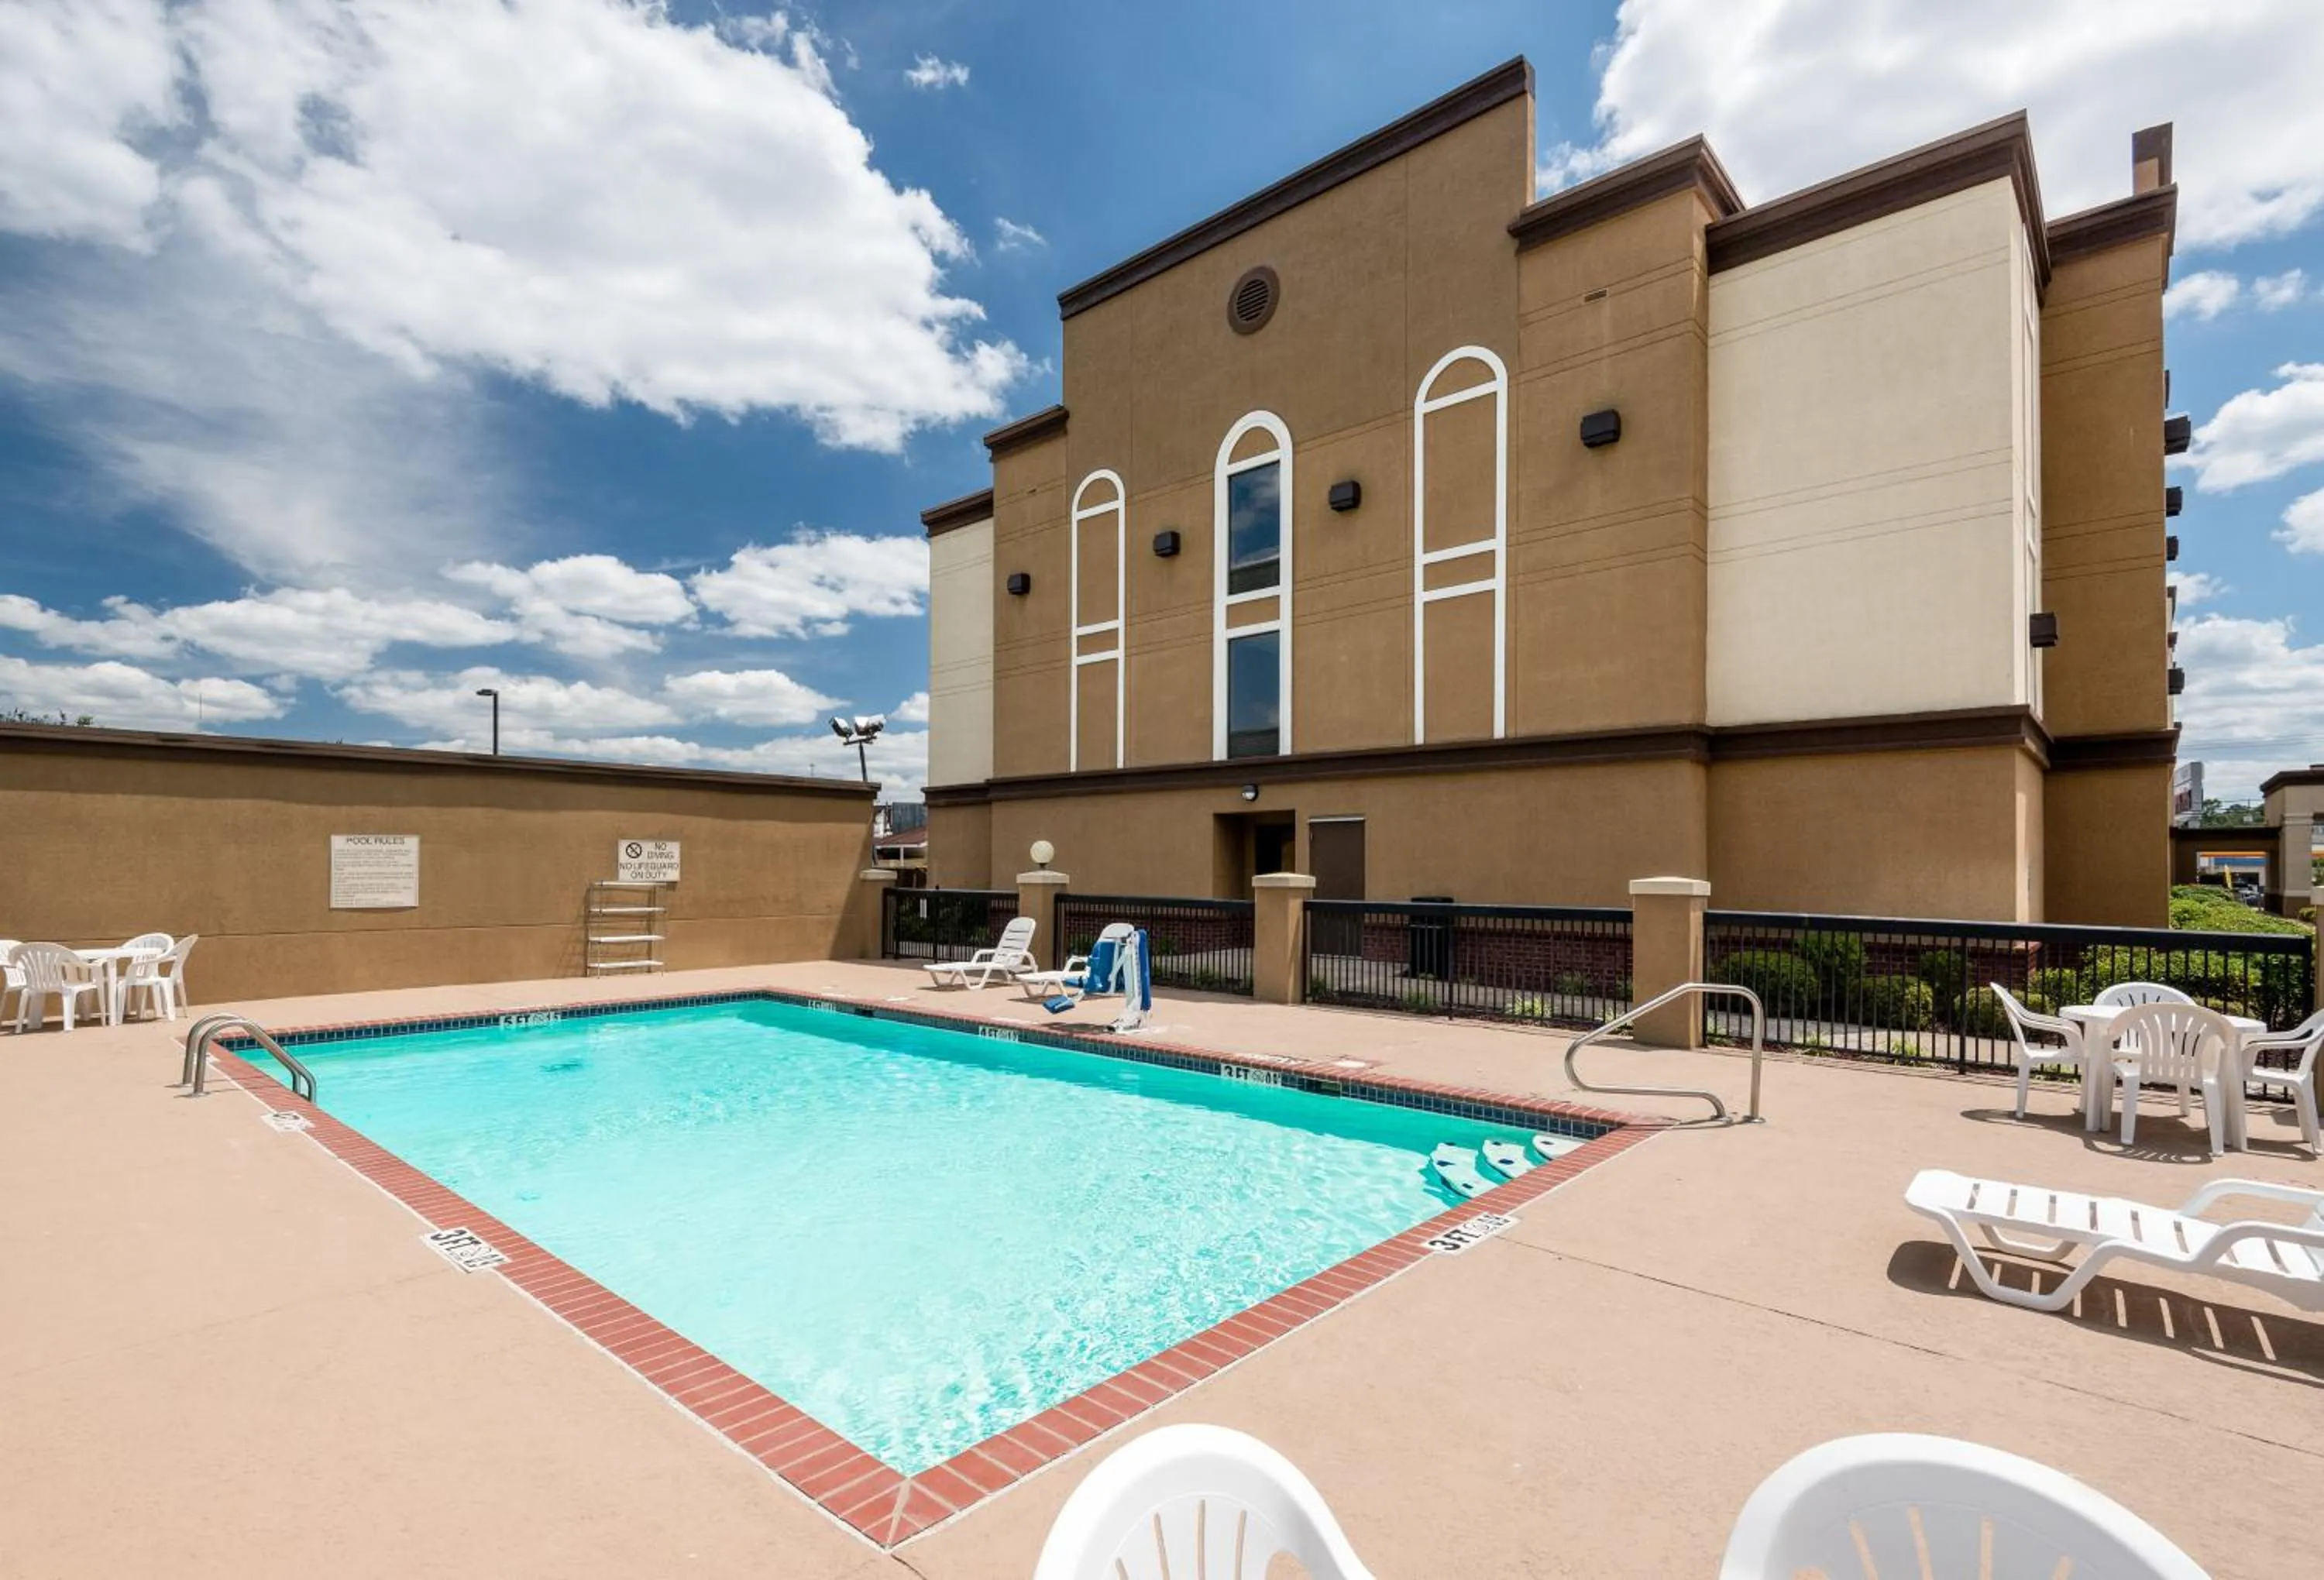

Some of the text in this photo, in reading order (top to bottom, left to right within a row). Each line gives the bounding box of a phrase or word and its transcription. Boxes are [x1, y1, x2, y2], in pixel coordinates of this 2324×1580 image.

[346, 836, 405, 845] POOL RULES
[655, 842, 667, 850] NO
[647, 851, 675, 860] DIVING
[619, 862, 679, 871] NO LIFEGUARD
[630, 871, 668, 879] ON DUTY
